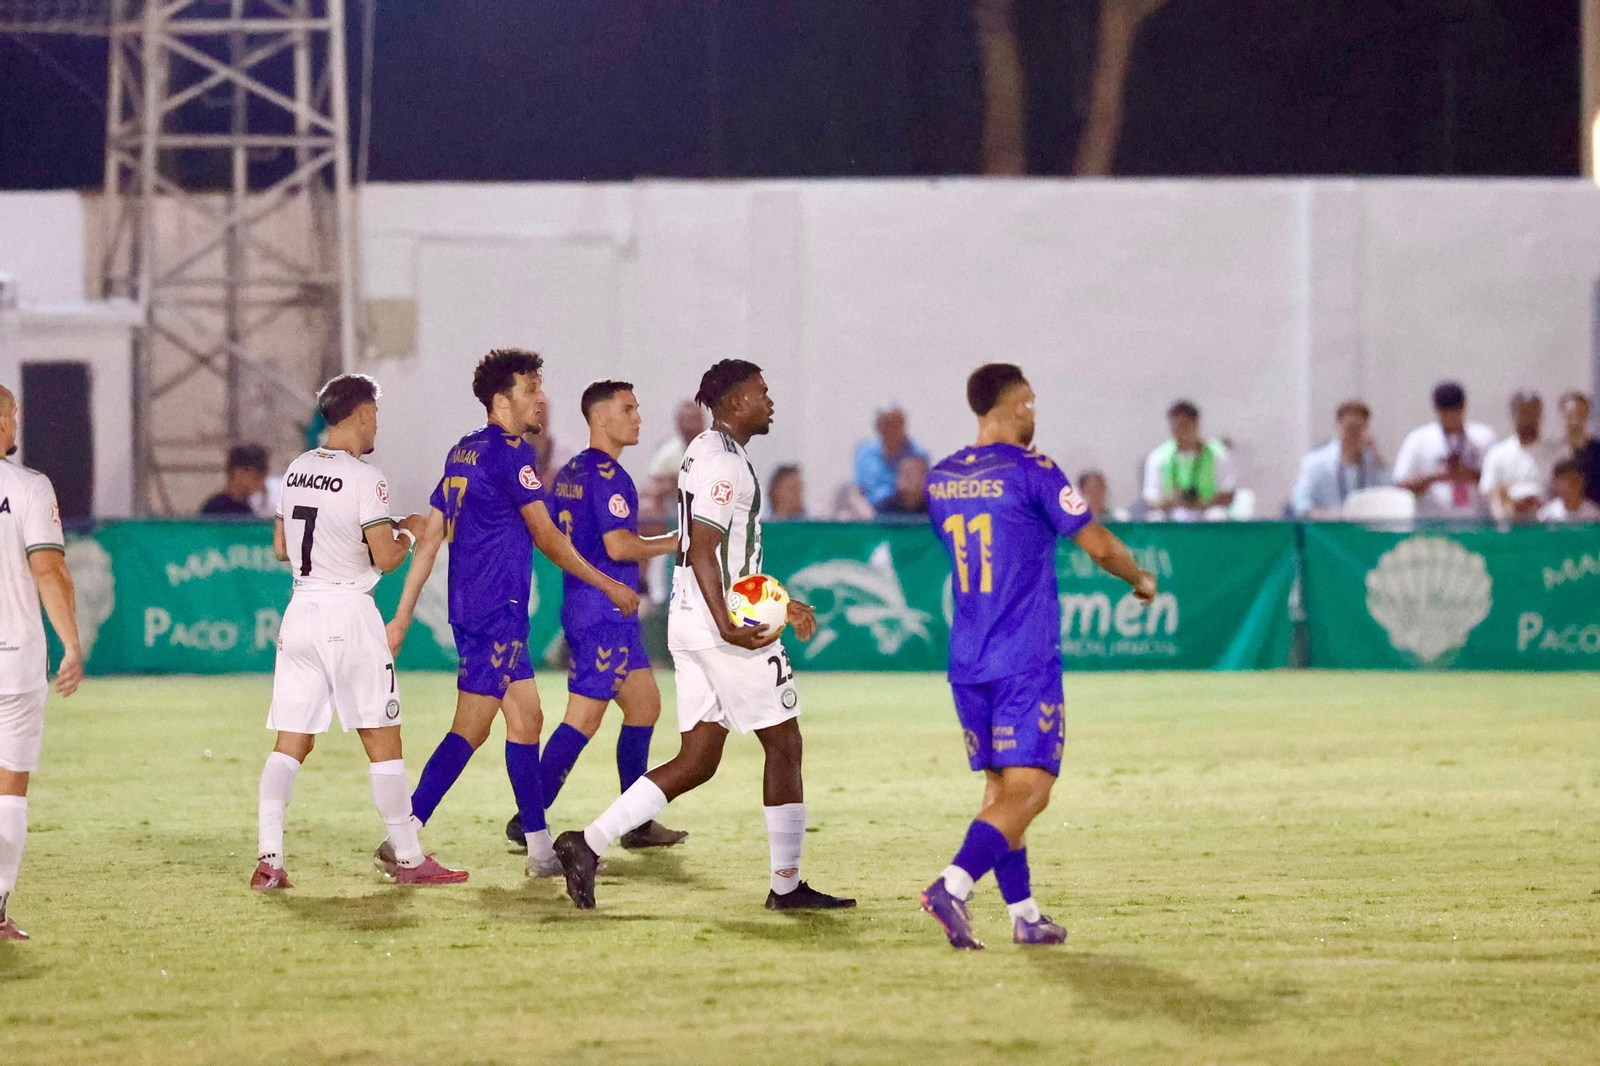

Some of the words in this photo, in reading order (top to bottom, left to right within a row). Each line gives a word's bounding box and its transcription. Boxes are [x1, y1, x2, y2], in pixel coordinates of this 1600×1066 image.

[286, 472, 343, 493] CAMACHO
[928, 479, 1004, 500] PAREDES
[292, 505, 319, 577] 7
[942, 513, 993, 593] 11
[615, 646, 629, 676] 2
[385, 663, 395, 694] 7
